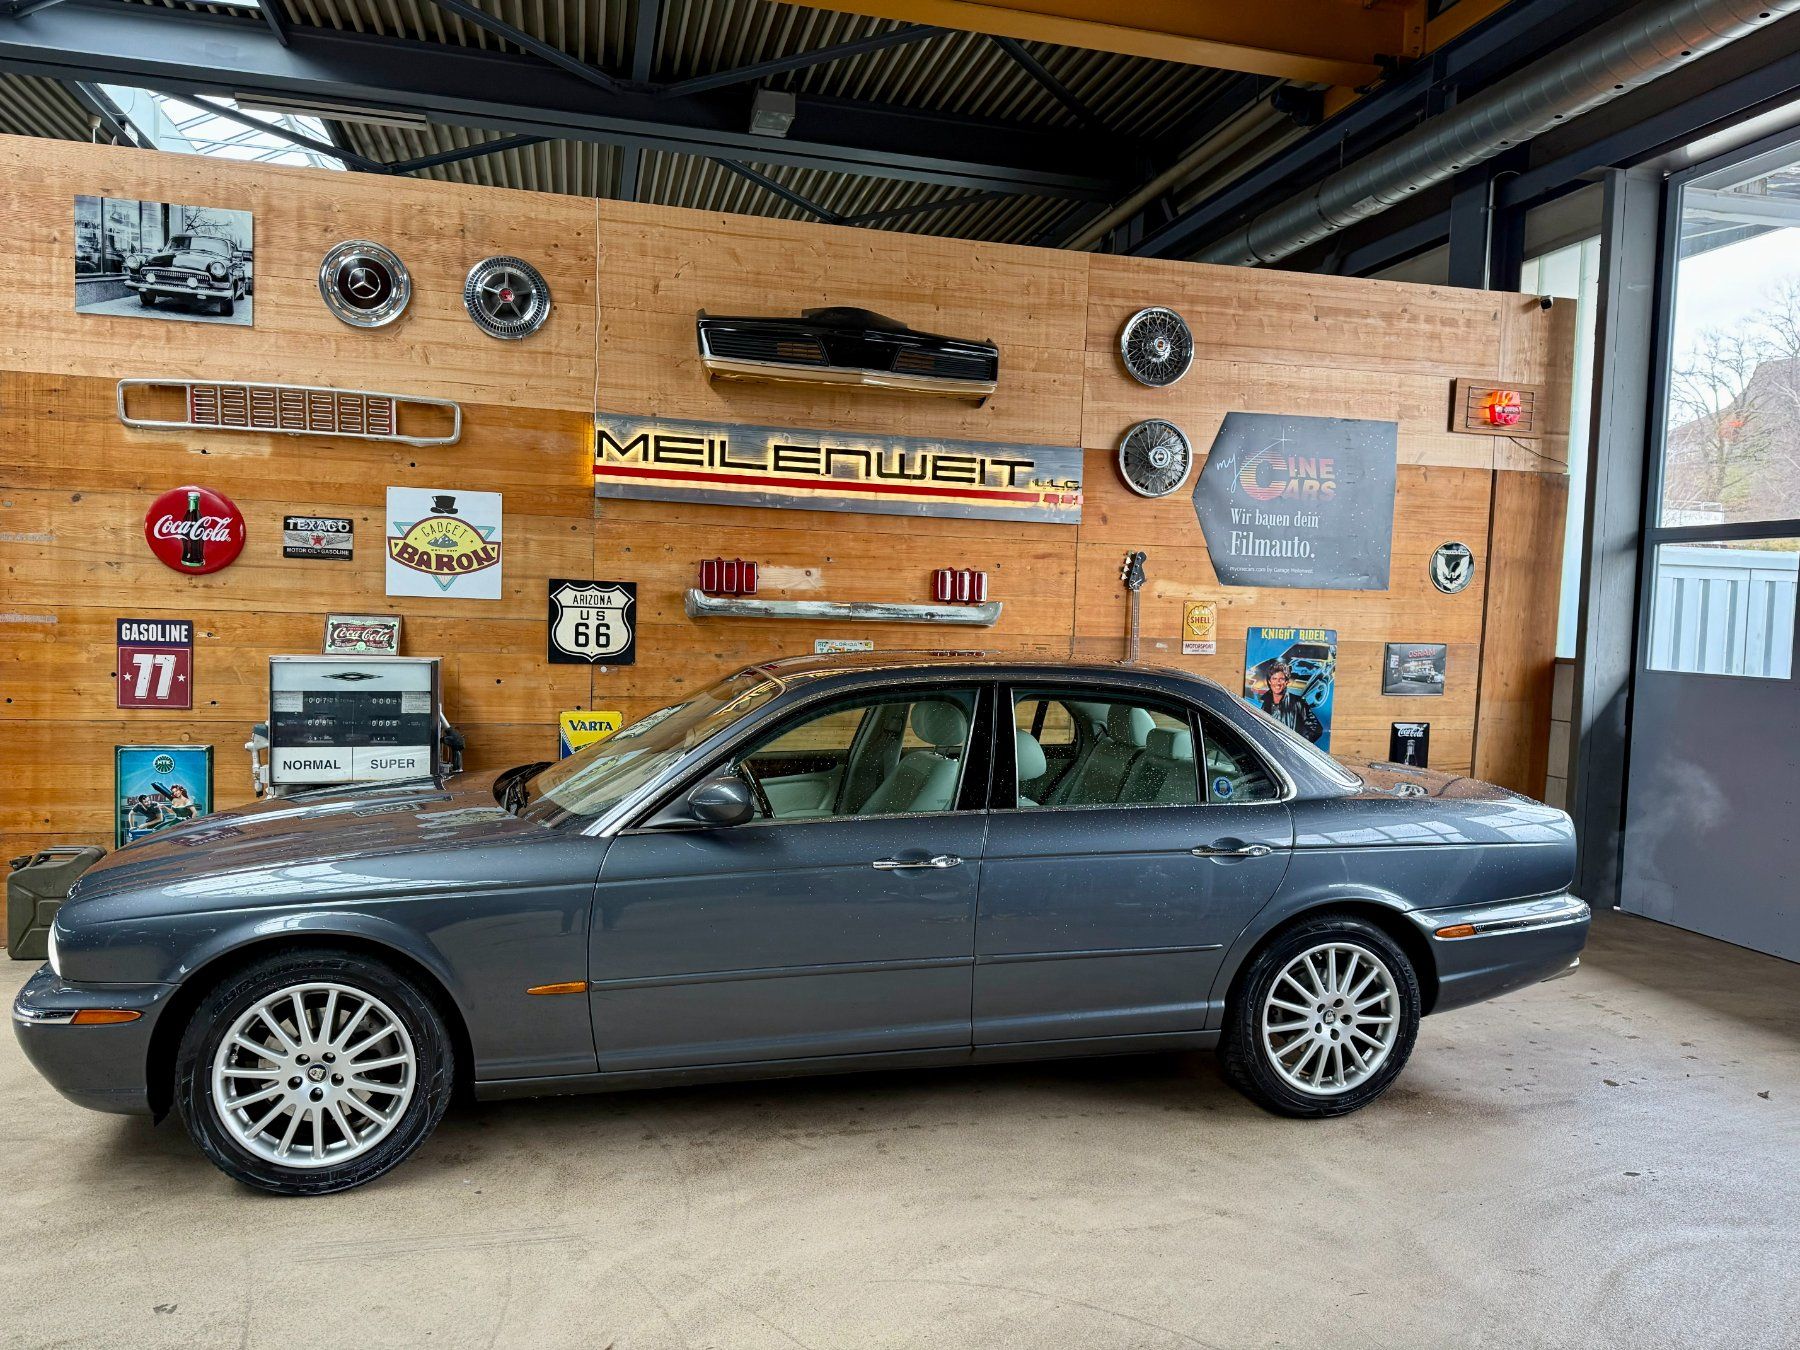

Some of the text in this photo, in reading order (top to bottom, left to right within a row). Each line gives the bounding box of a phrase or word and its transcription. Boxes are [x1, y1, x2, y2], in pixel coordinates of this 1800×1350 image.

[286, 519, 350, 533] TEXACO
[1230, 508, 1319, 528] Wir bauen dein
[153, 514, 231, 542] Coca-Cola
[421, 521, 469, 539] GADGET
[1229, 530, 1315, 558] Filmauto.
[396, 541, 496, 572] BARON
[572, 594, 613, 606] ARIZONA
[1190, 616, 1210, 624] SHELL
[121, 623, 189, 643] GASOLINE
[574, 622, 611, 648] 66
[1261, 628, 1296, 640] KNIGHT
[1408, 648, 1437, 659] OSRAM
[132, 653, 177, 700] 77
[568, 719, 614, 732] VARTA
[283, 759, 415, 770] NORMAL SUPER
